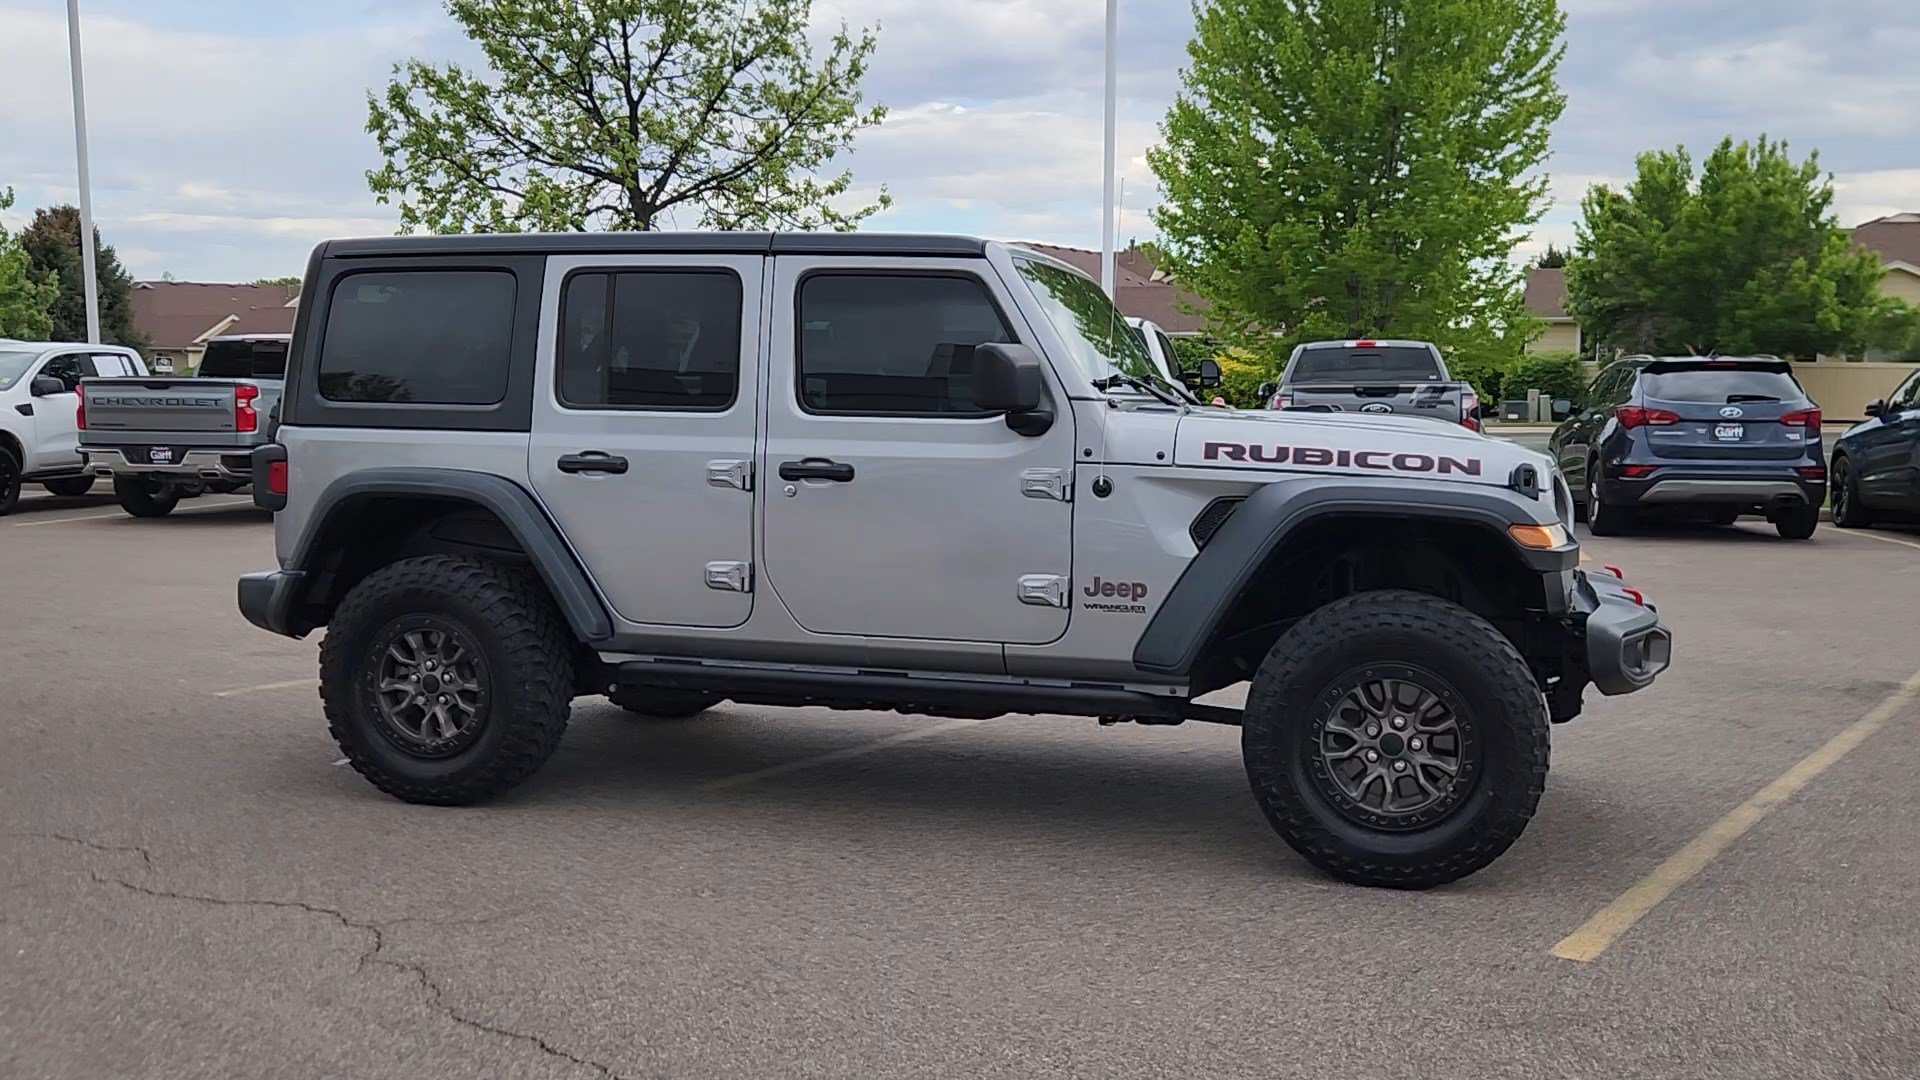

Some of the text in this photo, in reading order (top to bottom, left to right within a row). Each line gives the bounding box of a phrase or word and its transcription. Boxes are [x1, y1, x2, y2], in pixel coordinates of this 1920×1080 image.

[92, 397, 223, 407] CHEVROLET
[1714, 426, 1744, 438] Garff
[1203, 441, 1481, 477] RUBICON
[1084, 576, 1148, 602] Jeep
